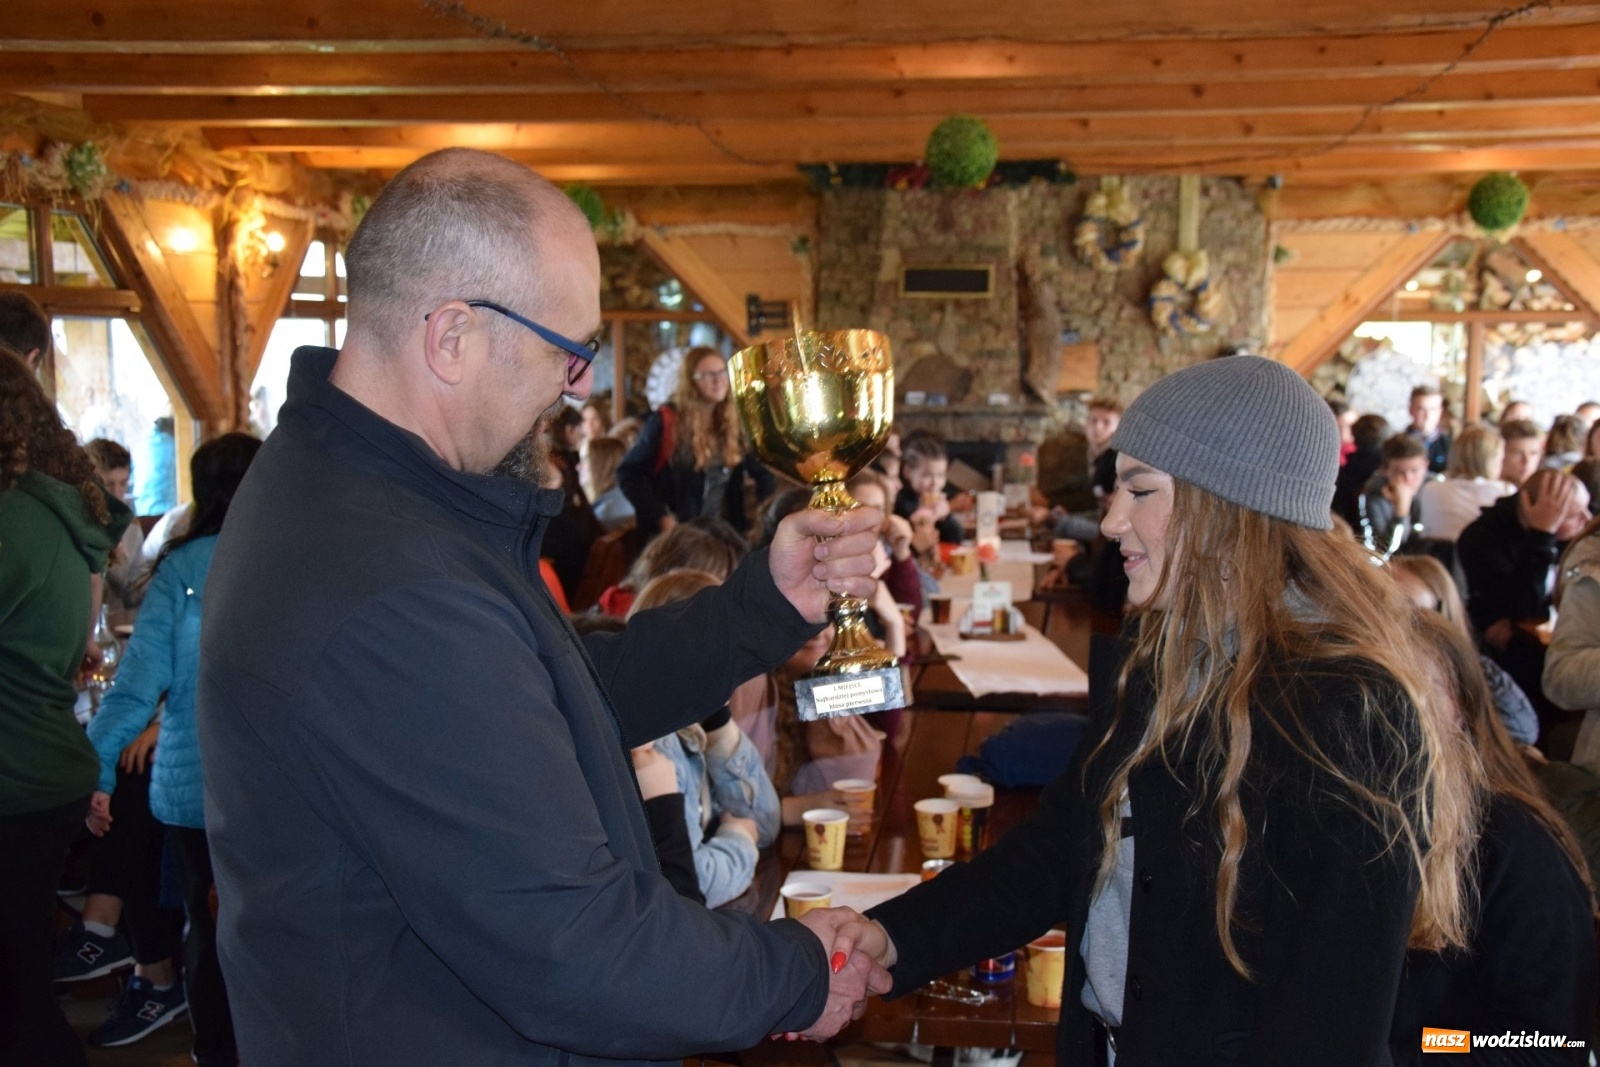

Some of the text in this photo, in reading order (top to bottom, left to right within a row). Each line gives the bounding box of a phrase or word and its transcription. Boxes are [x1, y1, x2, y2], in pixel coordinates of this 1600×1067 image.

[838, 682, 862, 691] MIEJSCE
[815, 688, 883, 703] Najbardziej pomysłowa
[828, 698, 873, 710] klasa pierwsza
